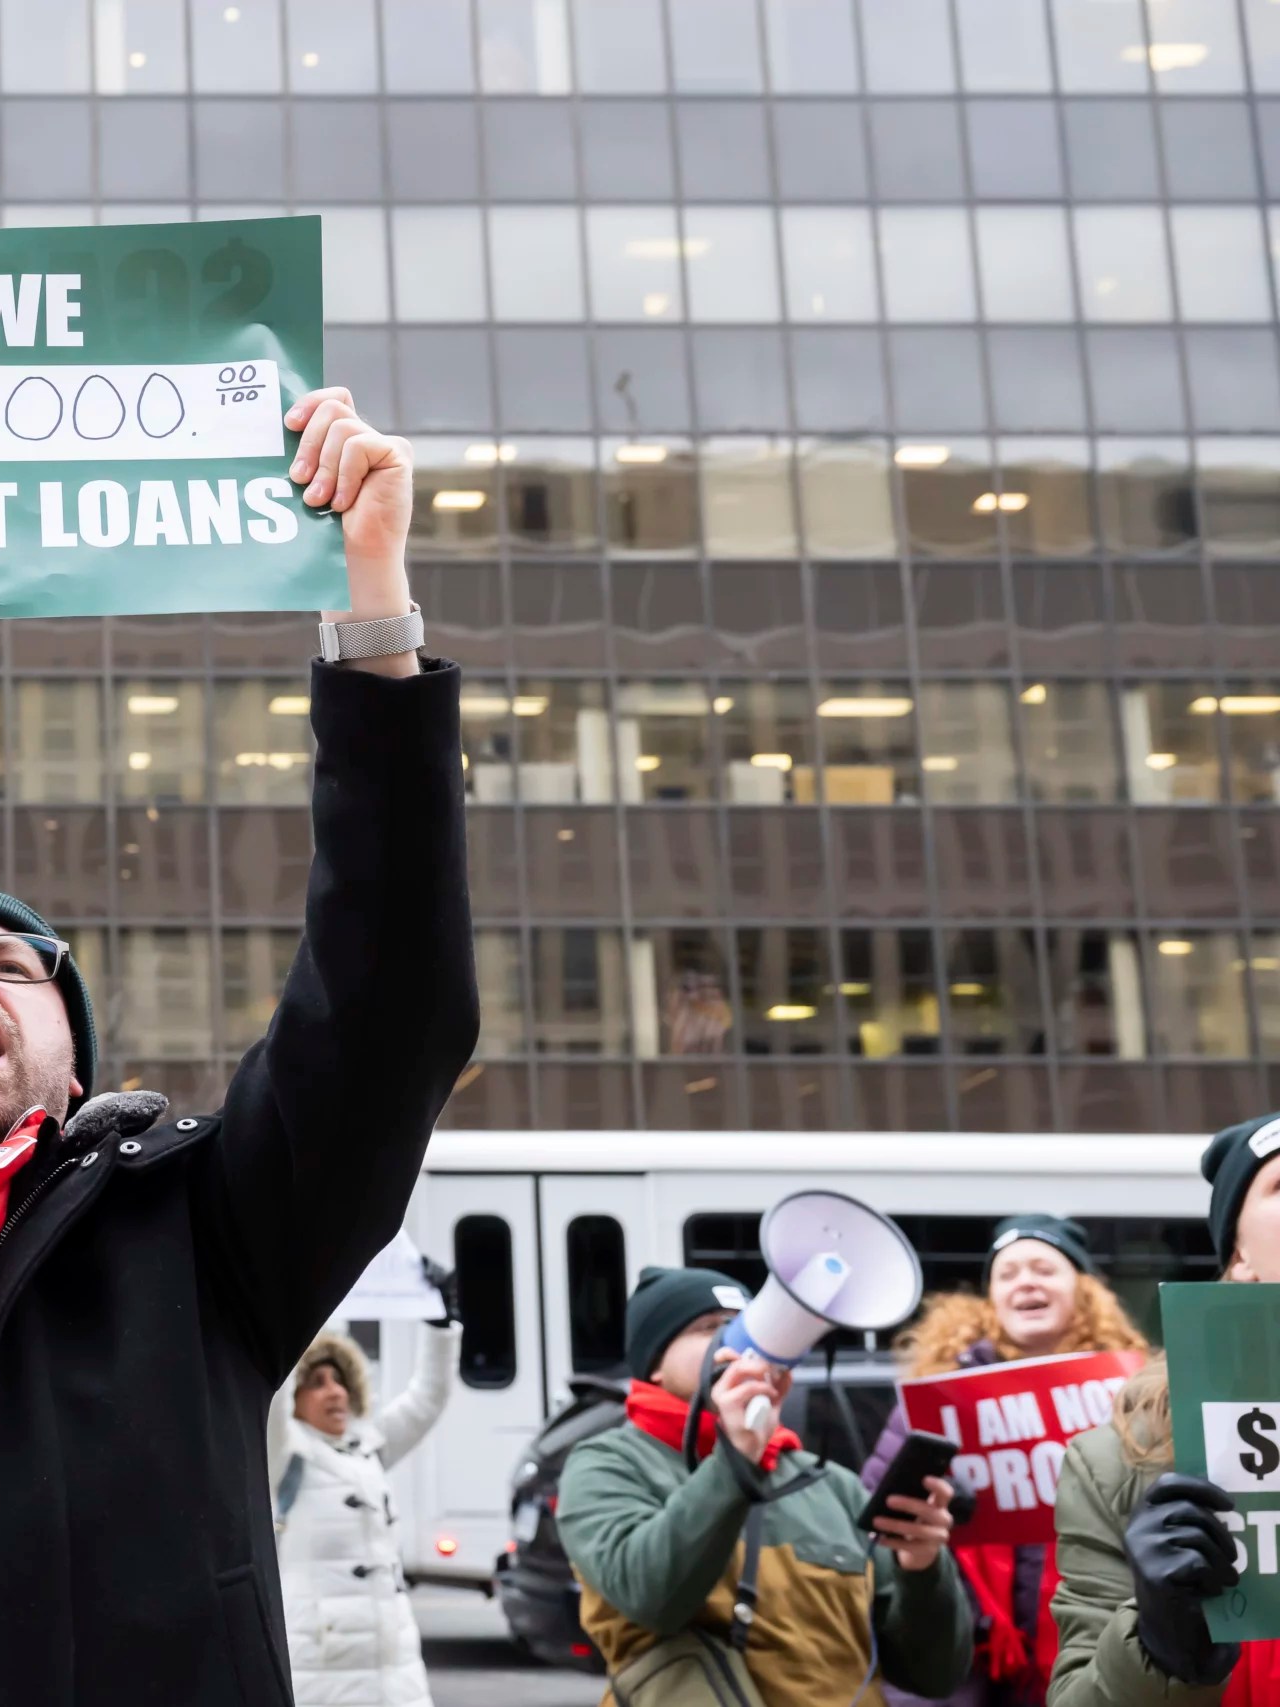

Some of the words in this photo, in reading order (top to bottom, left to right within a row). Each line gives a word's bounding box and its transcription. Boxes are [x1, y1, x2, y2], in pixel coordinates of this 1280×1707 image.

[39, 476, 300, 549] LOANS
[940, 1404, 964, 1449] I
[976, 1391, 1046, 1447] AM
[1236, 1407, 1280, 1481] $
